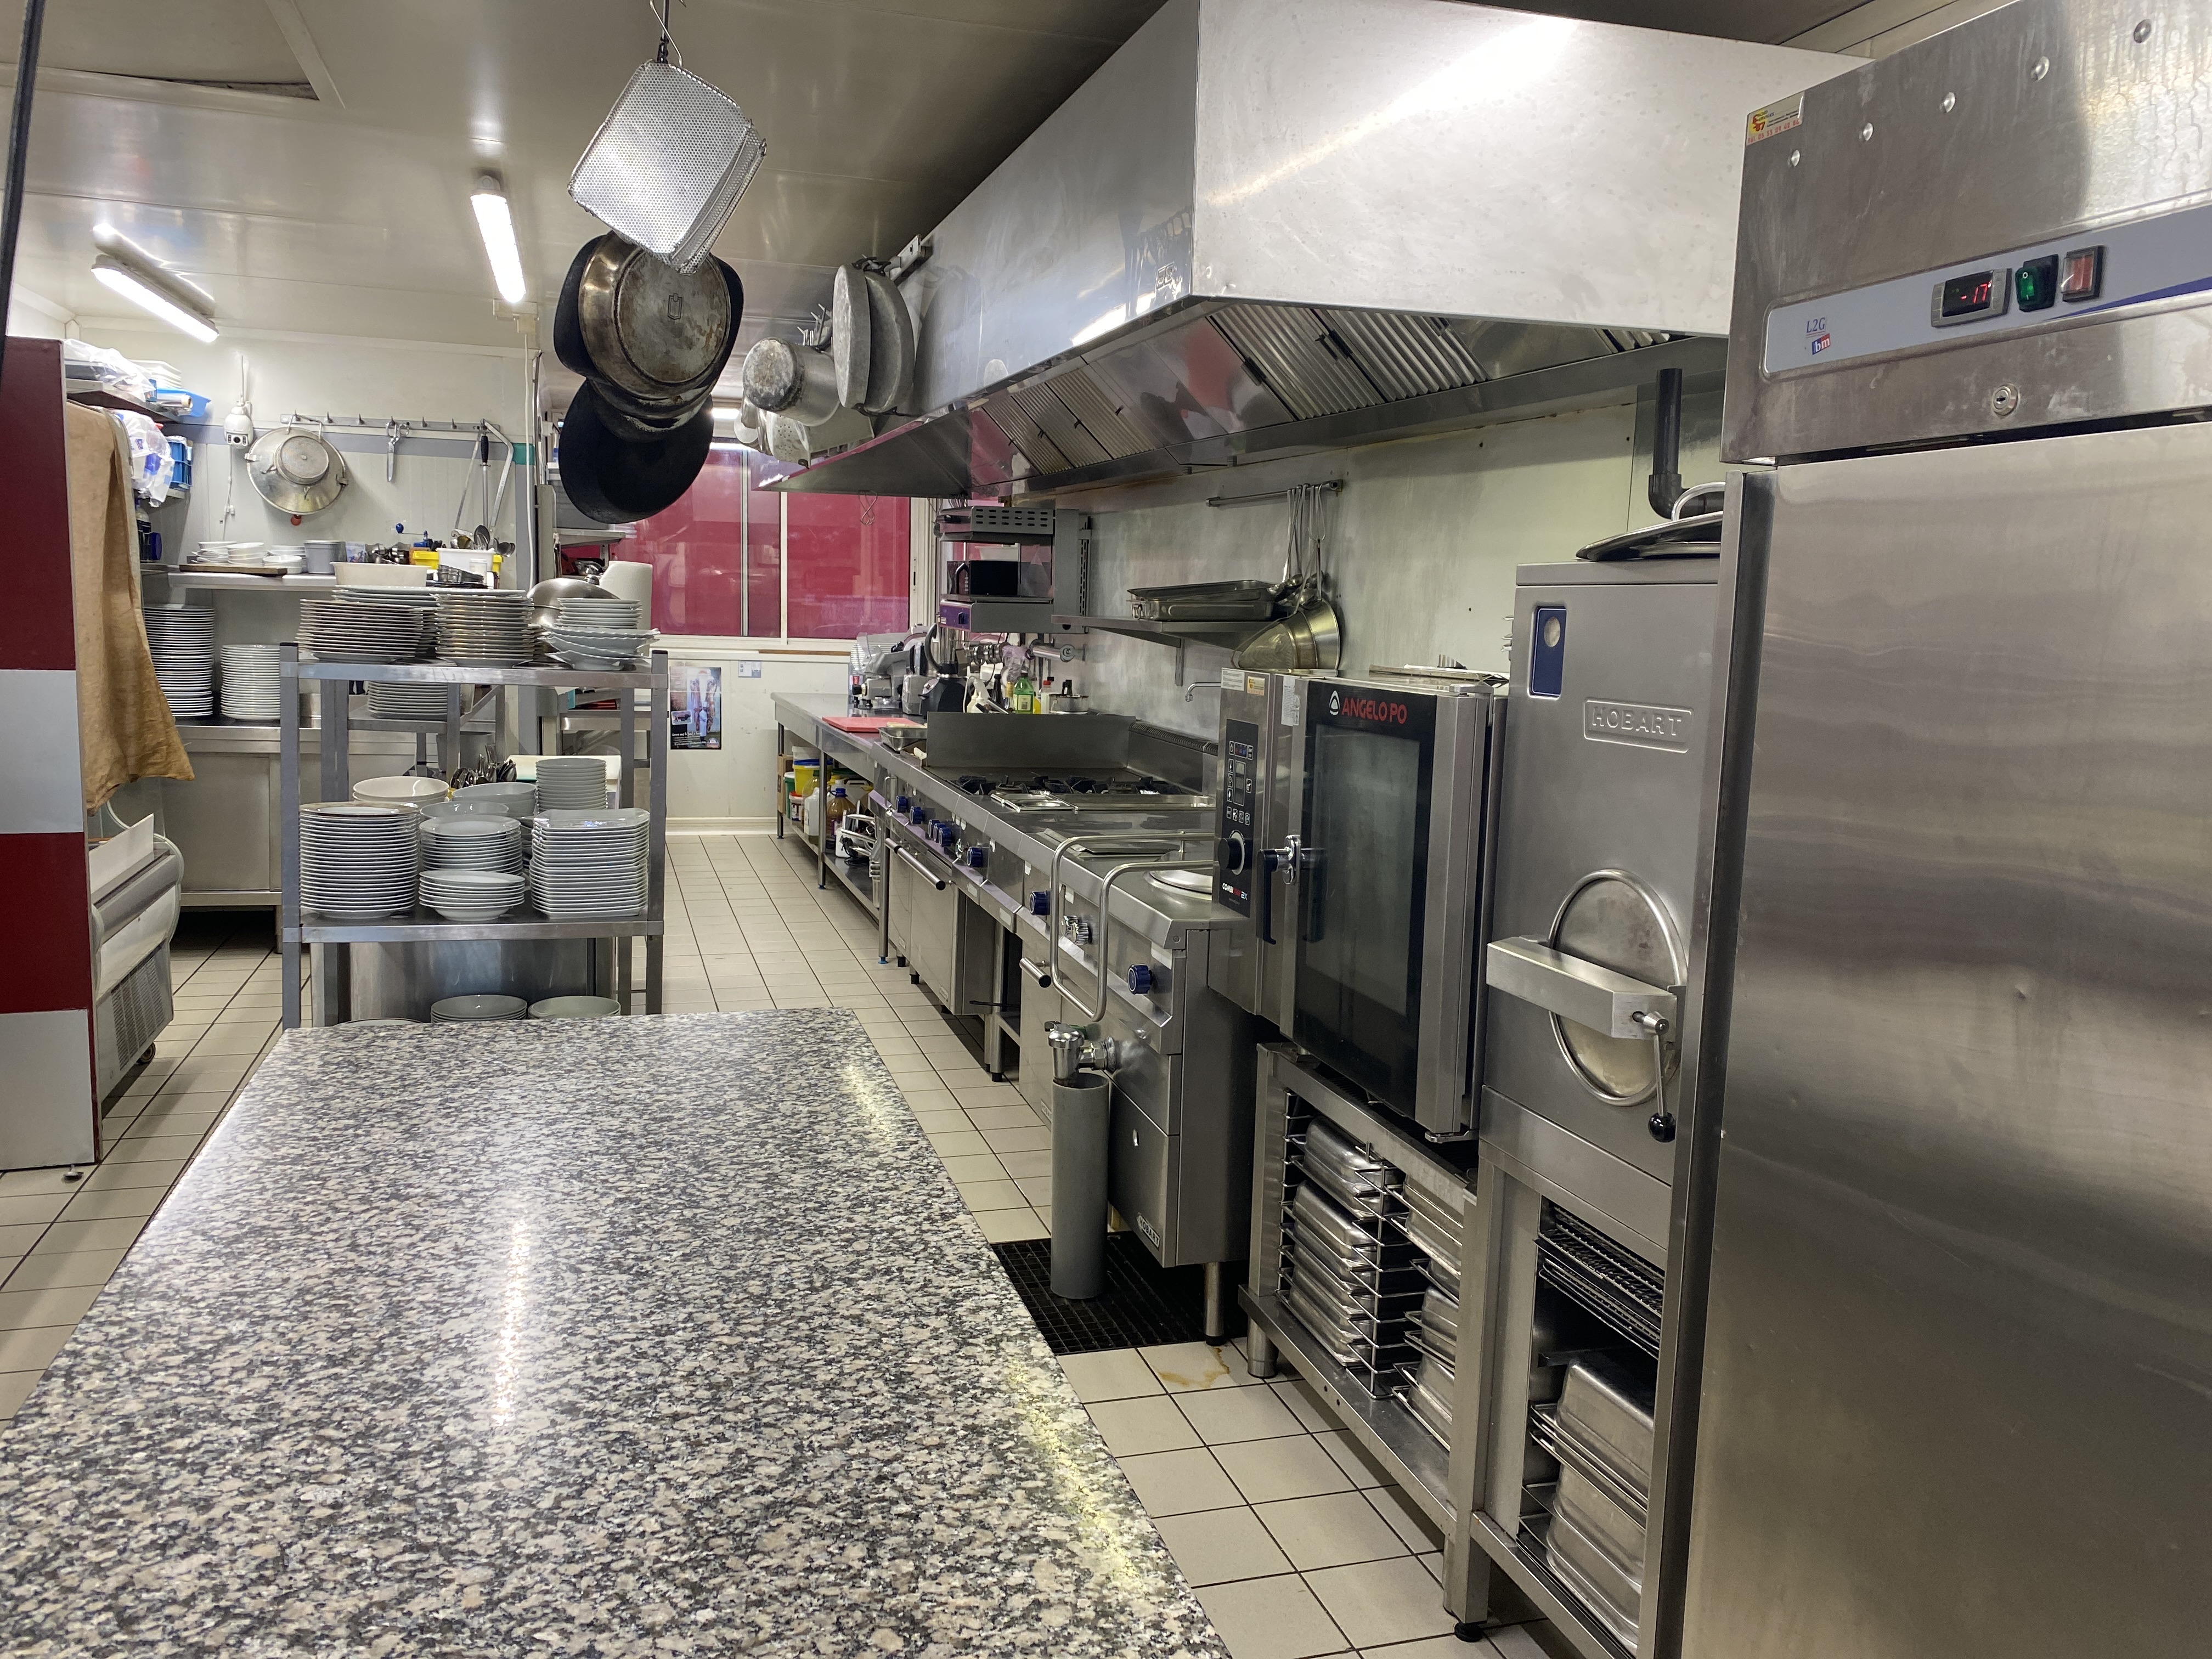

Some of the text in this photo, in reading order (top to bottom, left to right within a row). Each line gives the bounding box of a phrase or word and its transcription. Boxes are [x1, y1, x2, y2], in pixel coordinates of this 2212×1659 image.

[1807, 317, 1826, 333] L2G
[1815, 338, 1830, 352] bm
[1341, 697, 1407, 724] ANGELO PO
[1592, 707, 1682, 736] HOBART
[1140, 1216, 1159, 1245] HOBART
